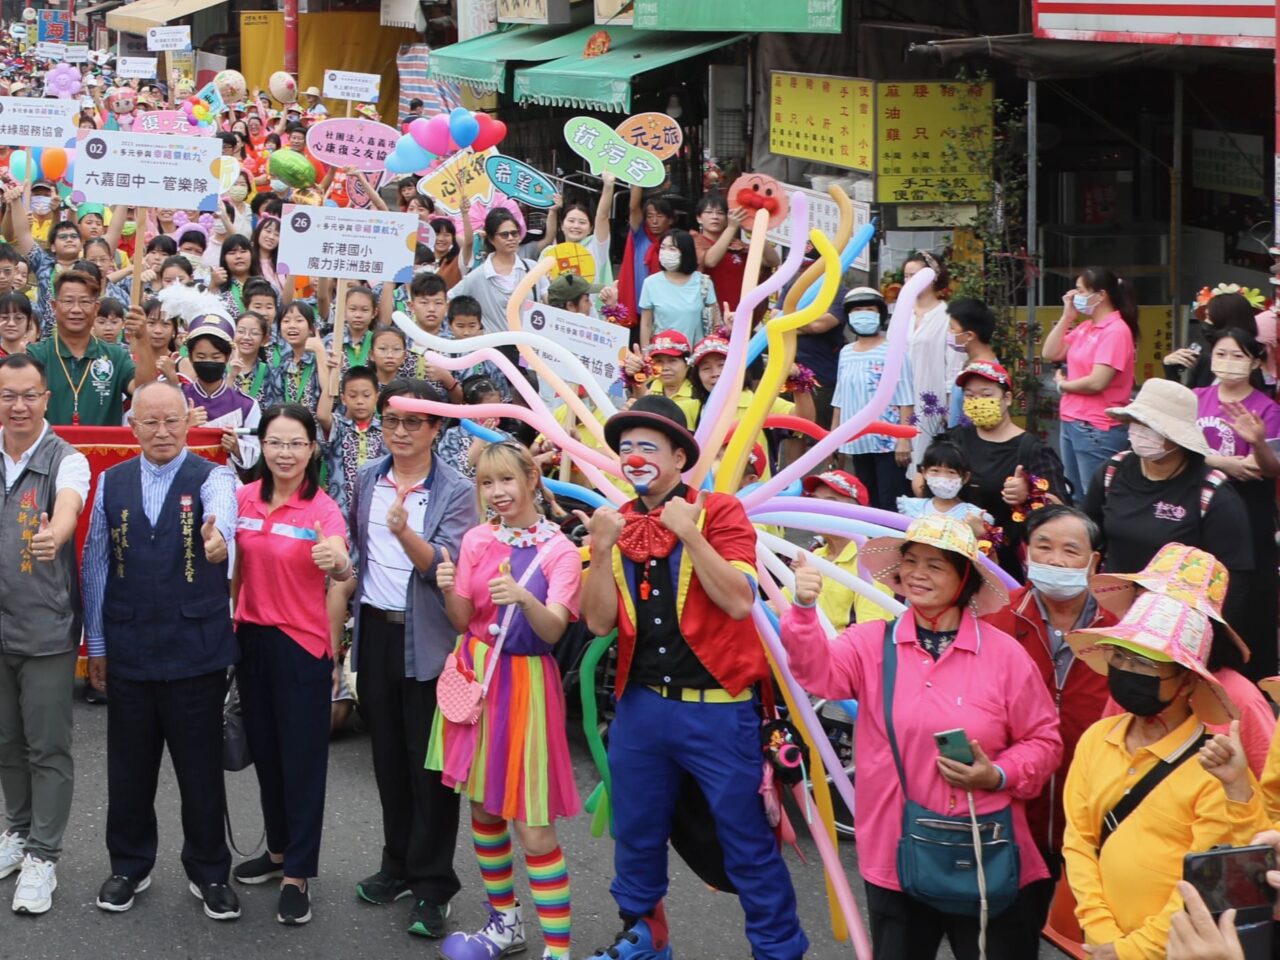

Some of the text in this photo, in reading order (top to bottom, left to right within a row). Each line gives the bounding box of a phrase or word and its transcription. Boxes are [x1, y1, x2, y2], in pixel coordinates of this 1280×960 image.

[884, 84, 901, 141] 麻油雞
[628, 125, 680, 151] 元之旅
[89, 143, 103, 154] 02
[574, 123, 653, 182] 抗污名
[495, 162, 533, 194] 希望
[294, 217, 308, 228] 26
[322, 242, 373, 258] 新港國小
[307, 257, 384, 274] 魔力非洲鼓團
[532, 315, 544, 326] 25
